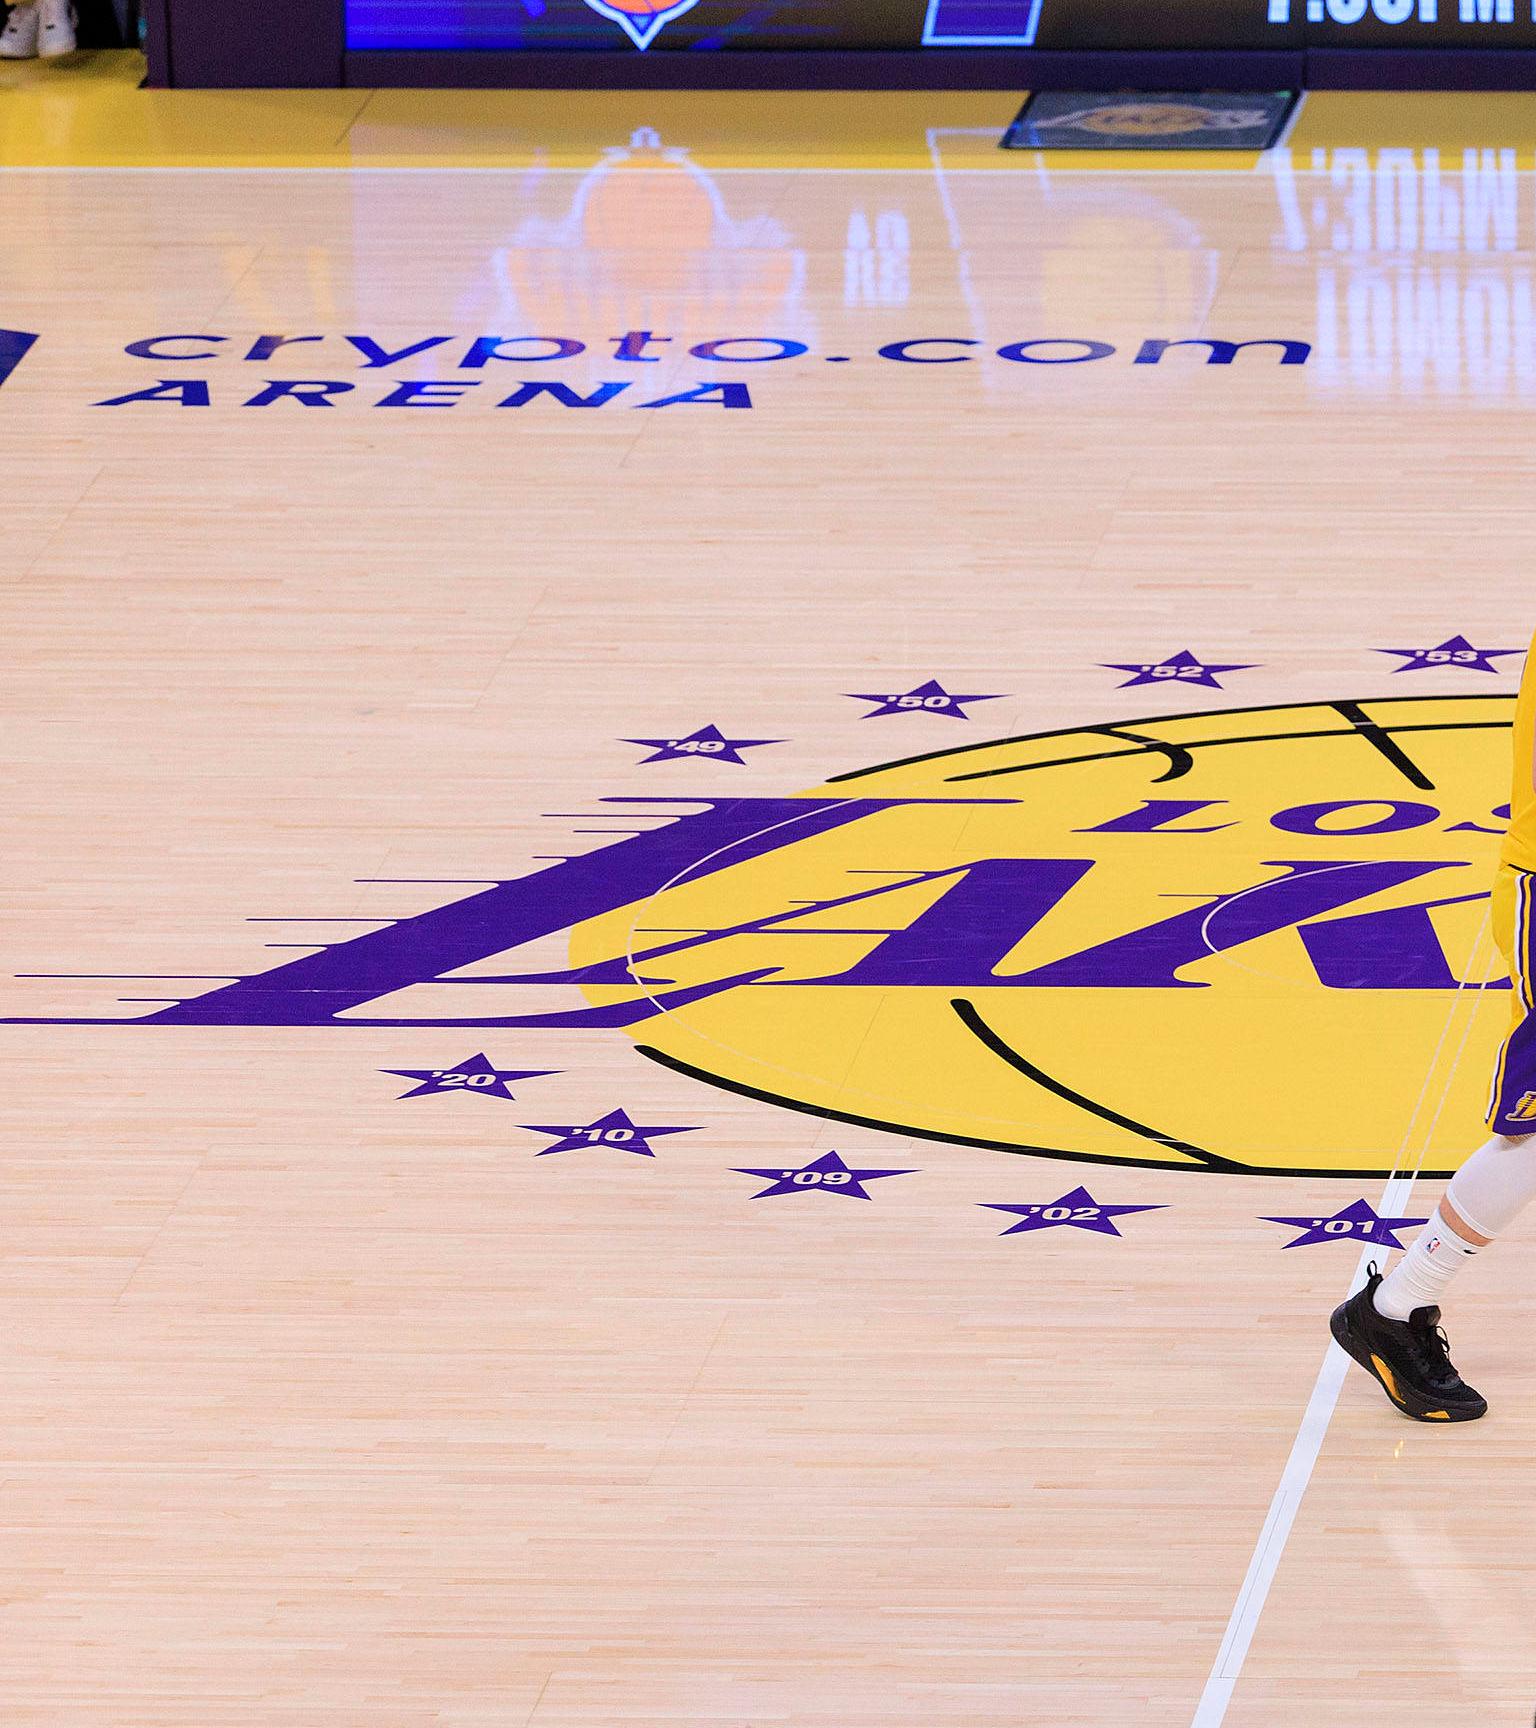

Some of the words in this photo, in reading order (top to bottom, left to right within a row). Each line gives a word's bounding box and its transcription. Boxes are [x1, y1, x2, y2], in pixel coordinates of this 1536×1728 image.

[124, 331, 1312, 369] crypto.com
[87, 379, 754, 409] ARENA
[1415, 650, 1478, 663] '53
[1141, 665, 1205, 678] '52
[886, 695, 951, 708] '50
[667, 740, 726, 753] '49
[431, 1071, 497, 1087] '20
[572, 1128, 635, 1142] '10
[780, 1171, 853, 1185] '09
[1029, 1207, 1102, 1221] '02
[1311, 1220, 1376, 1233] '01
